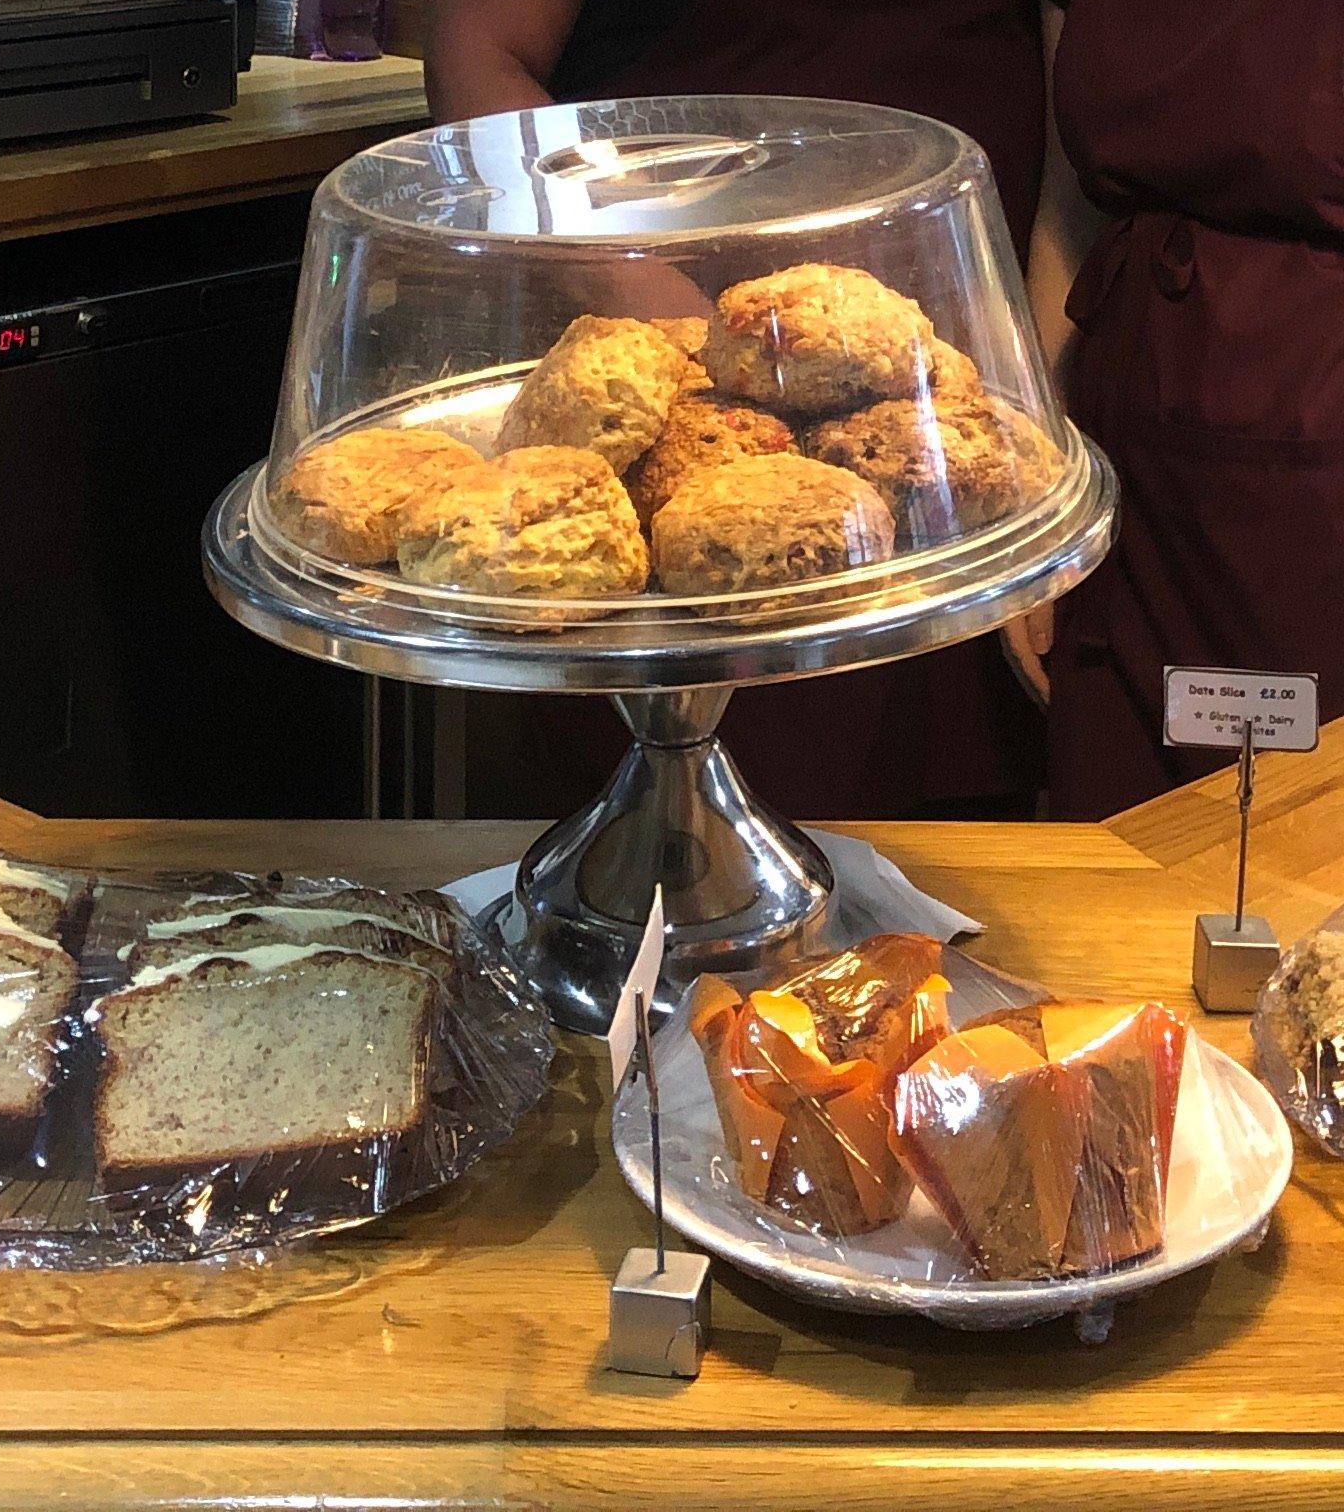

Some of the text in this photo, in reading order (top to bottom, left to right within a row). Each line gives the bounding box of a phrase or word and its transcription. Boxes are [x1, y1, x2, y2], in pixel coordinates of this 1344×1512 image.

[1188, 684, 1297, 701] Date Slice £2.00
[1208, 710, 1296, 728] Gluten Dairy
